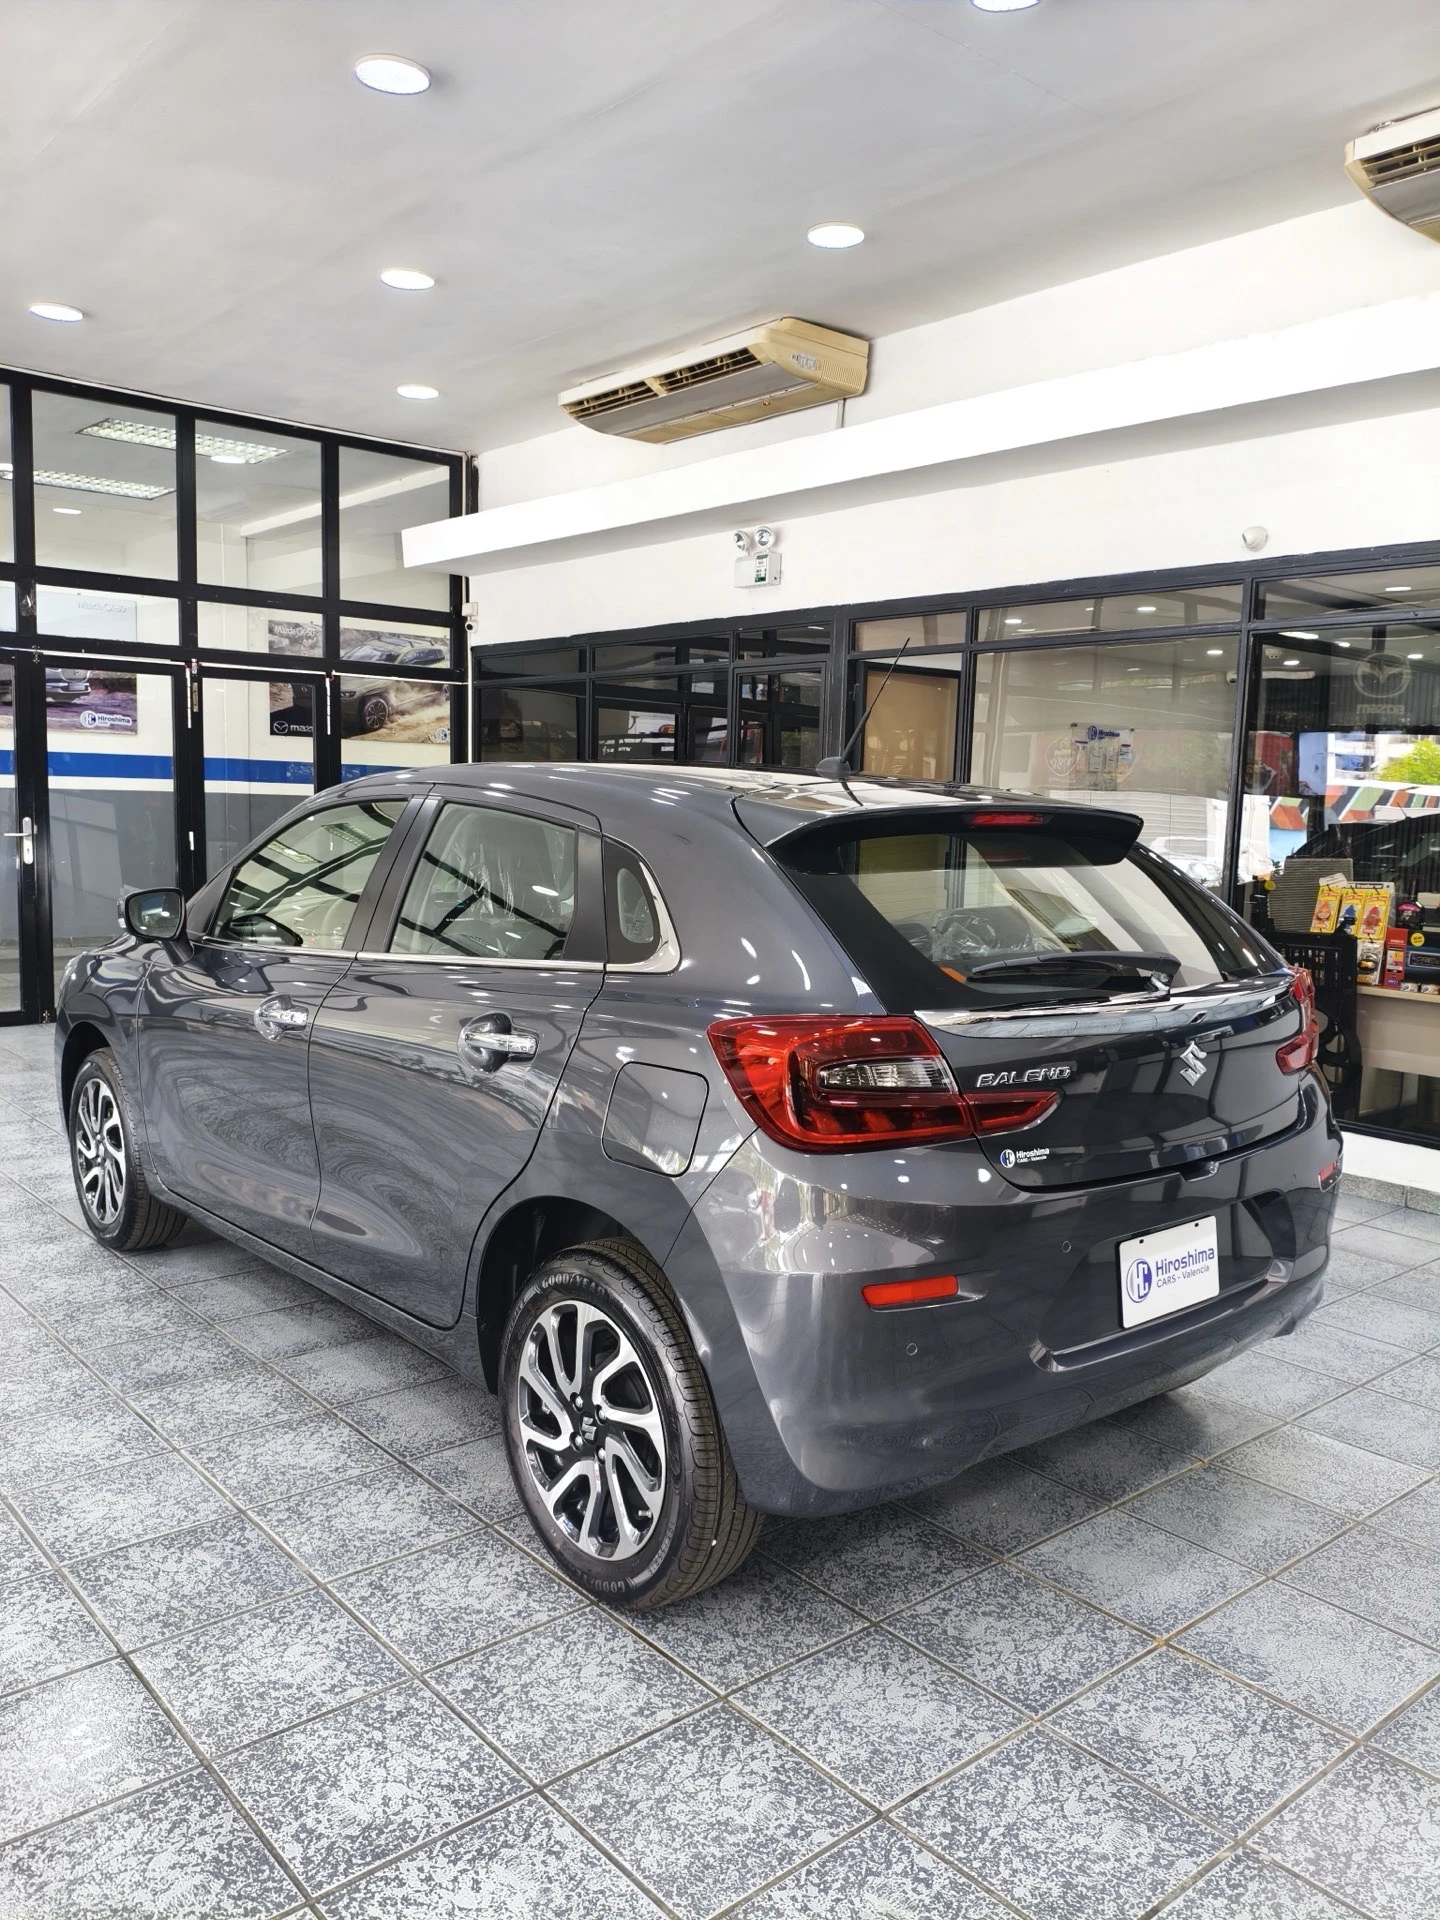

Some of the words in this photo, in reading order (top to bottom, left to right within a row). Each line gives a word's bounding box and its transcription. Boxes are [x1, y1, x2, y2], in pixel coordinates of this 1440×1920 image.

[274, 625, 296, 635] Mazda
[97, 715, 131, 723] Hiroshima
[976, 1066, 1072, 1088] BALENO
[1016, 1148, 1050, 1159] Hiroshima
[1155, 1247, 1215, 1277] Hiroshima
[541, 1273, 607, 1297] GOODYEAR
[1156, 1274, 1177, 1288] CARS
[1182, 1264, 1210, 1280] Valencia
